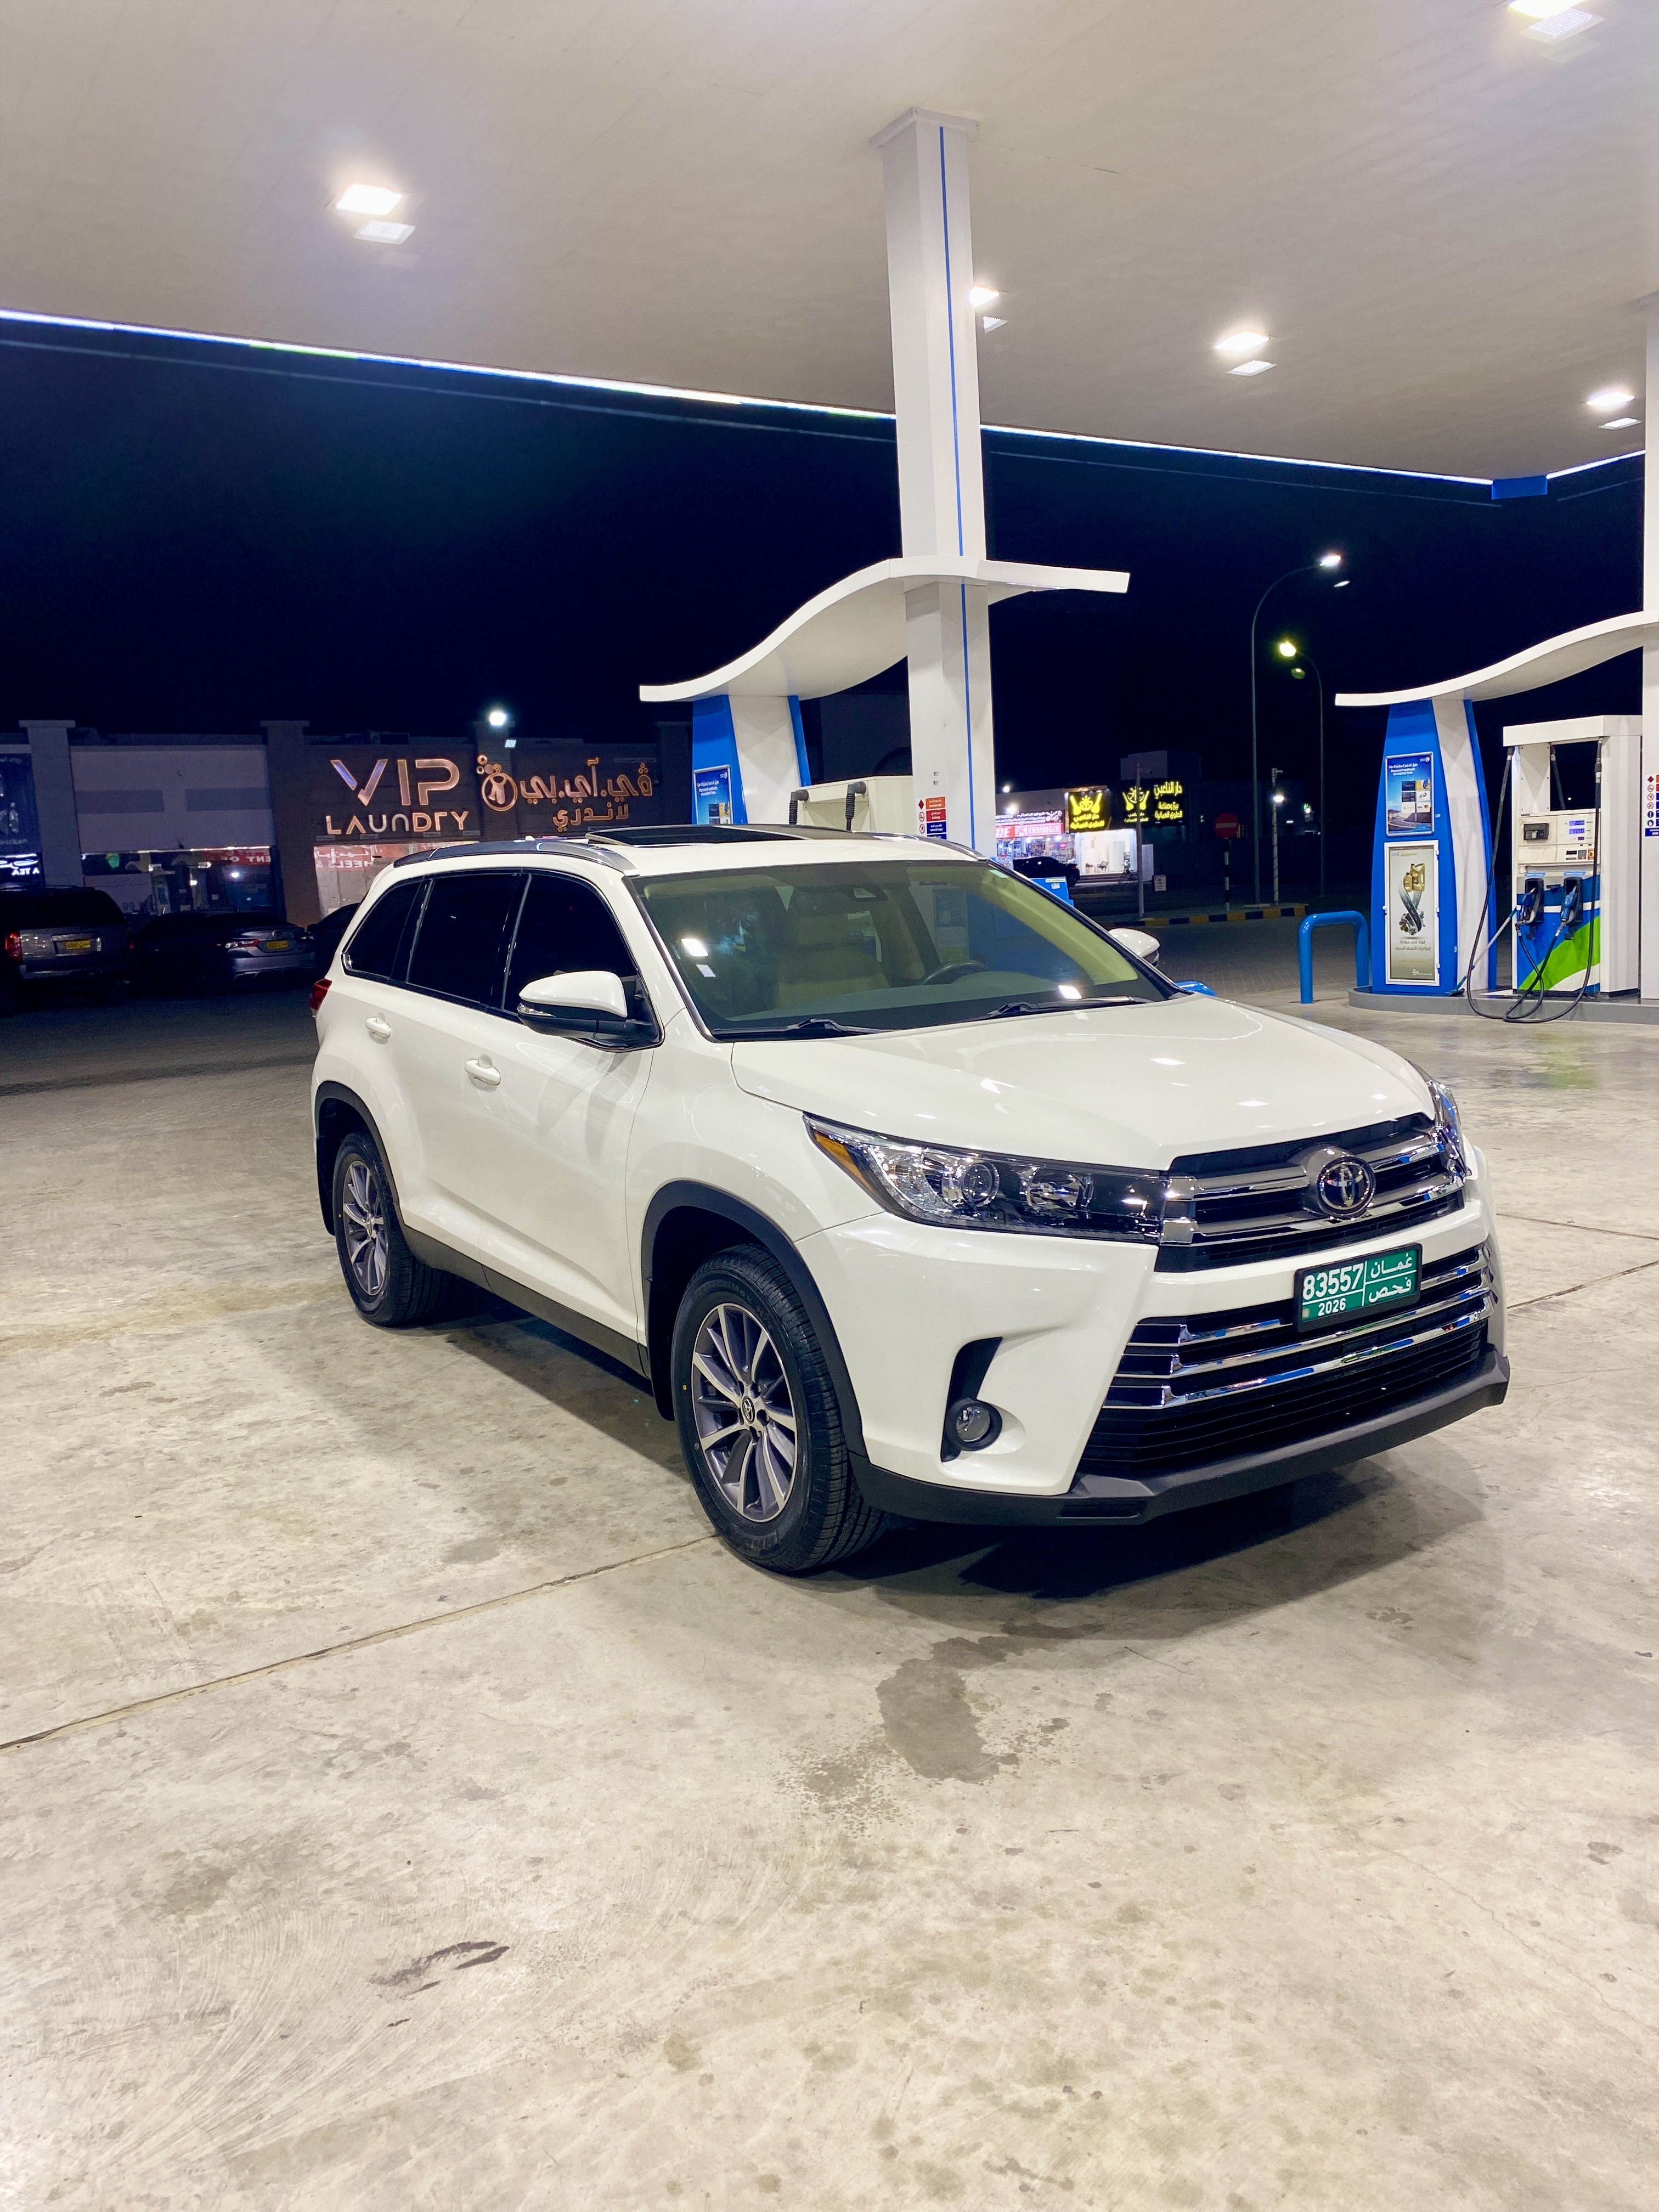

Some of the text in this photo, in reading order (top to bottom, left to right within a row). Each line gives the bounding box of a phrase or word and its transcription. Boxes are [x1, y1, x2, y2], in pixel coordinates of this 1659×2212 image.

[330, 759, 460, 806] VIP
[326, 811, 469, 834] LAUNDRY
[552, 802, 630, 833] لاندري
[1302, 1263, 1364, 1300] 83557
[1368, 1277, 1412, 1302] فحص
[1318, 1297, 1346, 1317] 2026
